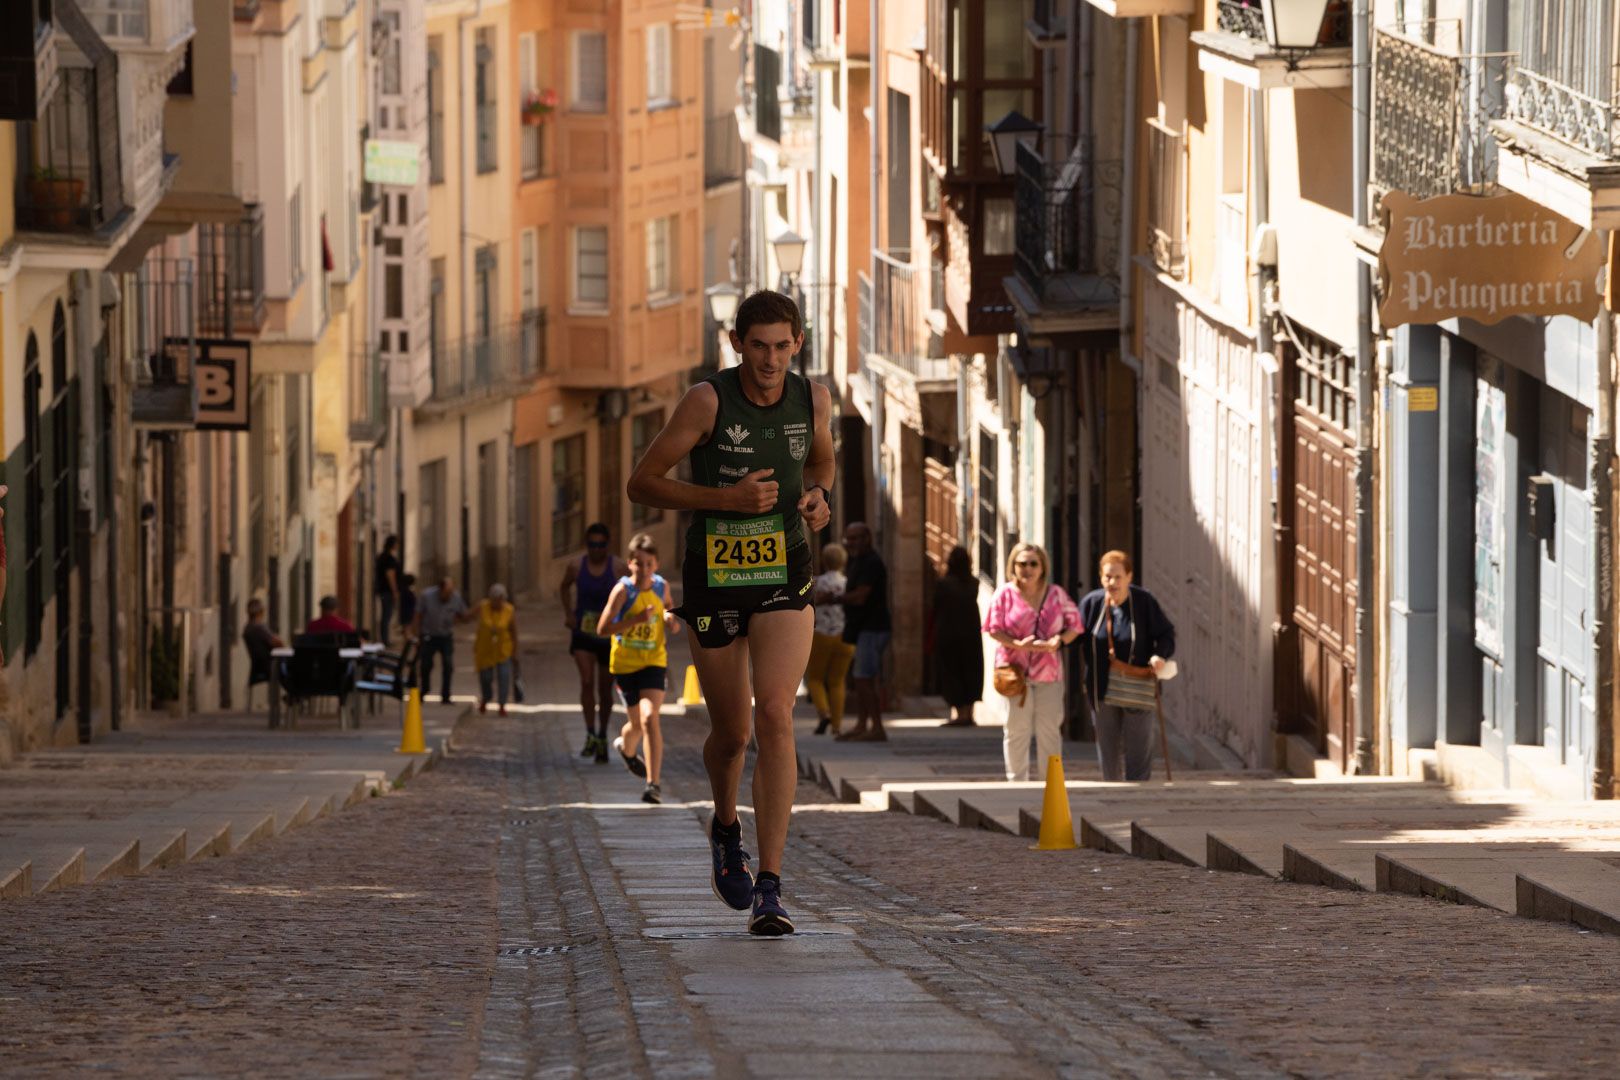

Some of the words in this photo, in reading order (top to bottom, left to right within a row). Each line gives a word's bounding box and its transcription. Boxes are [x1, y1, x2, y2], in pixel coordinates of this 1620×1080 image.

[717, 444, 733, 452] CAJA
[749, 526, 775, 535] RURAL
[714, 537, 777, 565] 2433
[730, 572, 752, 581] CAJA
[751, 571, 783, 580] RURAL
